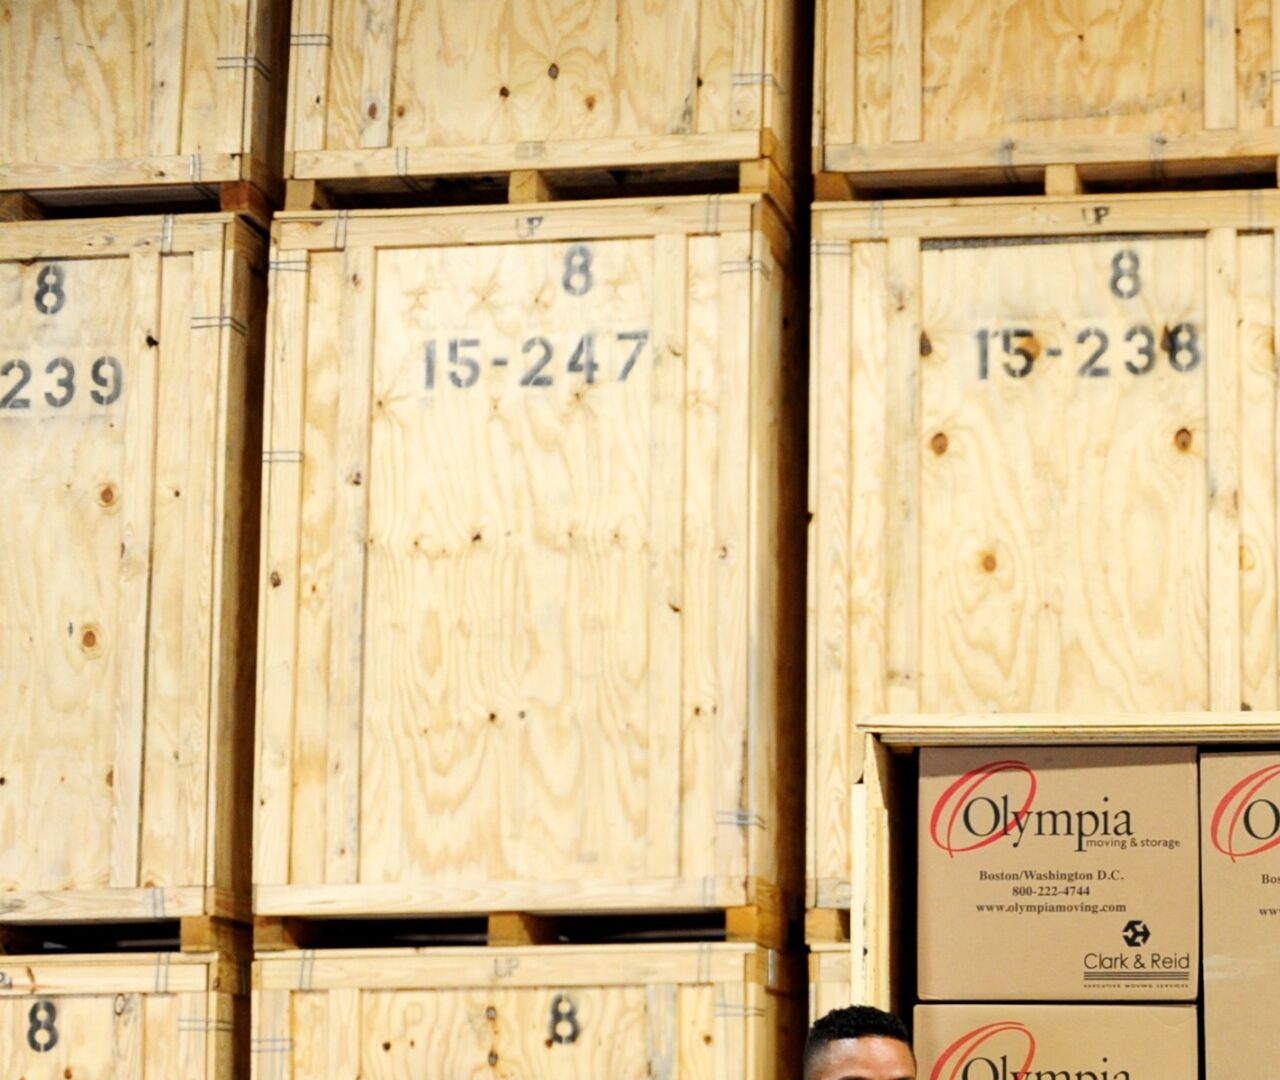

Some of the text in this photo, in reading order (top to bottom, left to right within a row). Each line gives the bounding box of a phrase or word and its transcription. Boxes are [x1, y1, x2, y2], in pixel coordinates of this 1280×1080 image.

[34, 265, 66, 315] 8
[562, 246, 594, 296] 8
[1110, 249, 1141, 300] 8
[424, 329, 649, 390] 15-247
[975, 323, 1201, 380] 15-238
[0, 356, 124, 409] 239
[963, 794, 1134, 852] Olympia
[1086, 837, 1181, 850] moving & storage
[979, 869, 1124, 882] Boston/Washington D.C.
[1012, 886, 1090, 897] 800-222-4744
[976, 902, 1127, 915] www.olympiamoving.com
[1083, 952, 1190, 970] Clark & Reid
[27, 1001, 59, 1053] 8
[551, 993, 580, 1044] 8
